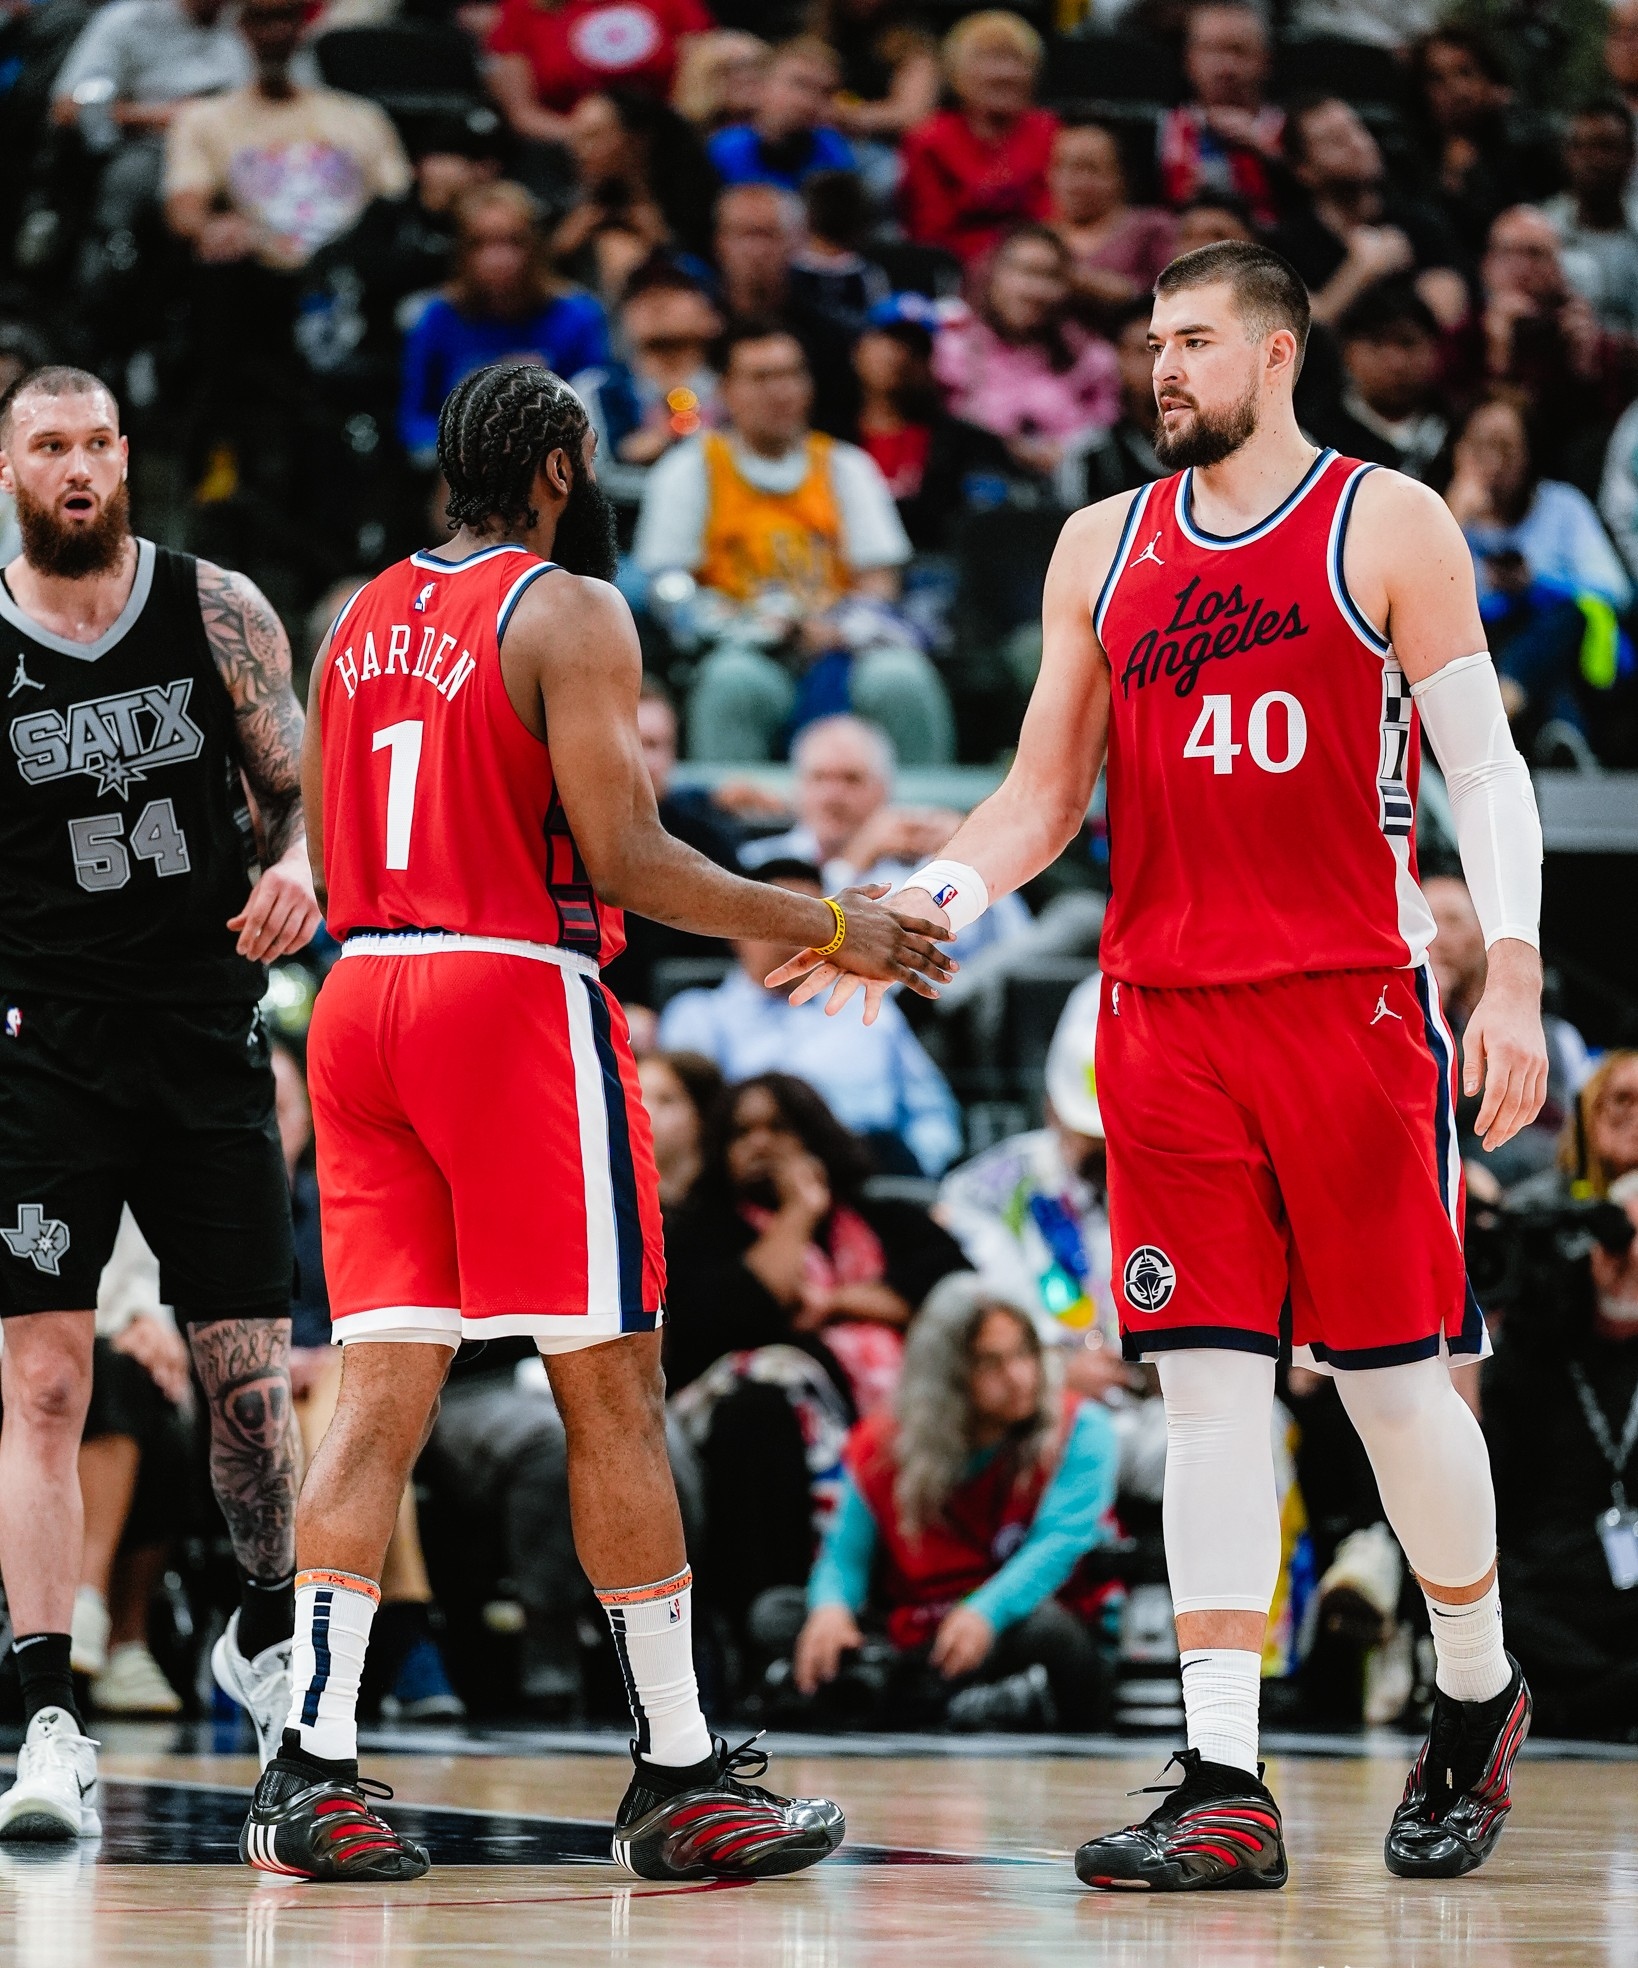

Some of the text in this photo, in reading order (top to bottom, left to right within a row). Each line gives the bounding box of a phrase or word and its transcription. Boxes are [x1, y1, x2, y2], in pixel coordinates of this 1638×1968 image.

[1121, 598, 1308, 698] Angeles
[1166, 577, 1246, 635] Los
[335, 624, 476, 702] HARDEN
[10, 679, 204, 786] SATX
[1183, 690, 1308, 775] 40
[371, 720, 424, 870] 1
[69, 799, 191, 892] 54
